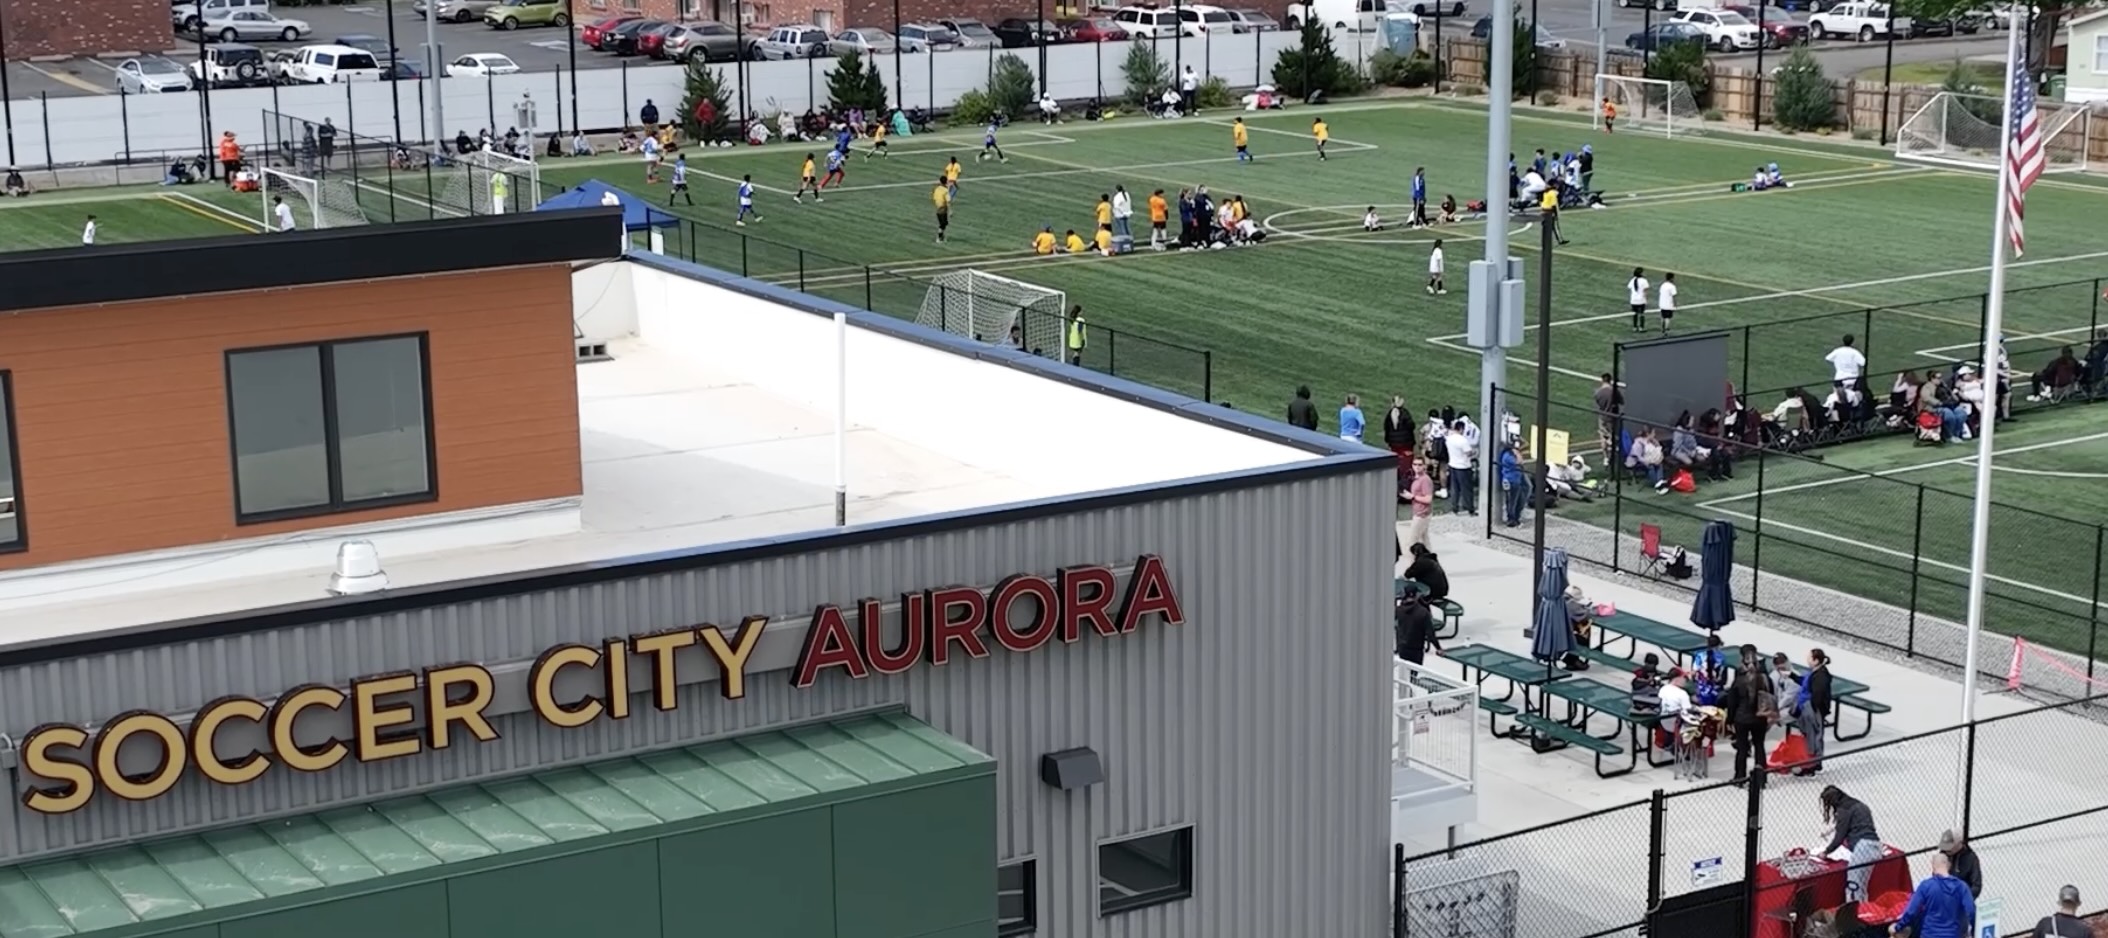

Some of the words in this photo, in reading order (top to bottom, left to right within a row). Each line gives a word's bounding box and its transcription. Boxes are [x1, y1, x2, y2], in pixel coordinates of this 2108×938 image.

[22, 661, 500, 814] SOCCER
[528, 615, 768, 728] CITY
[790, 553, 1186, 688] AURORA
